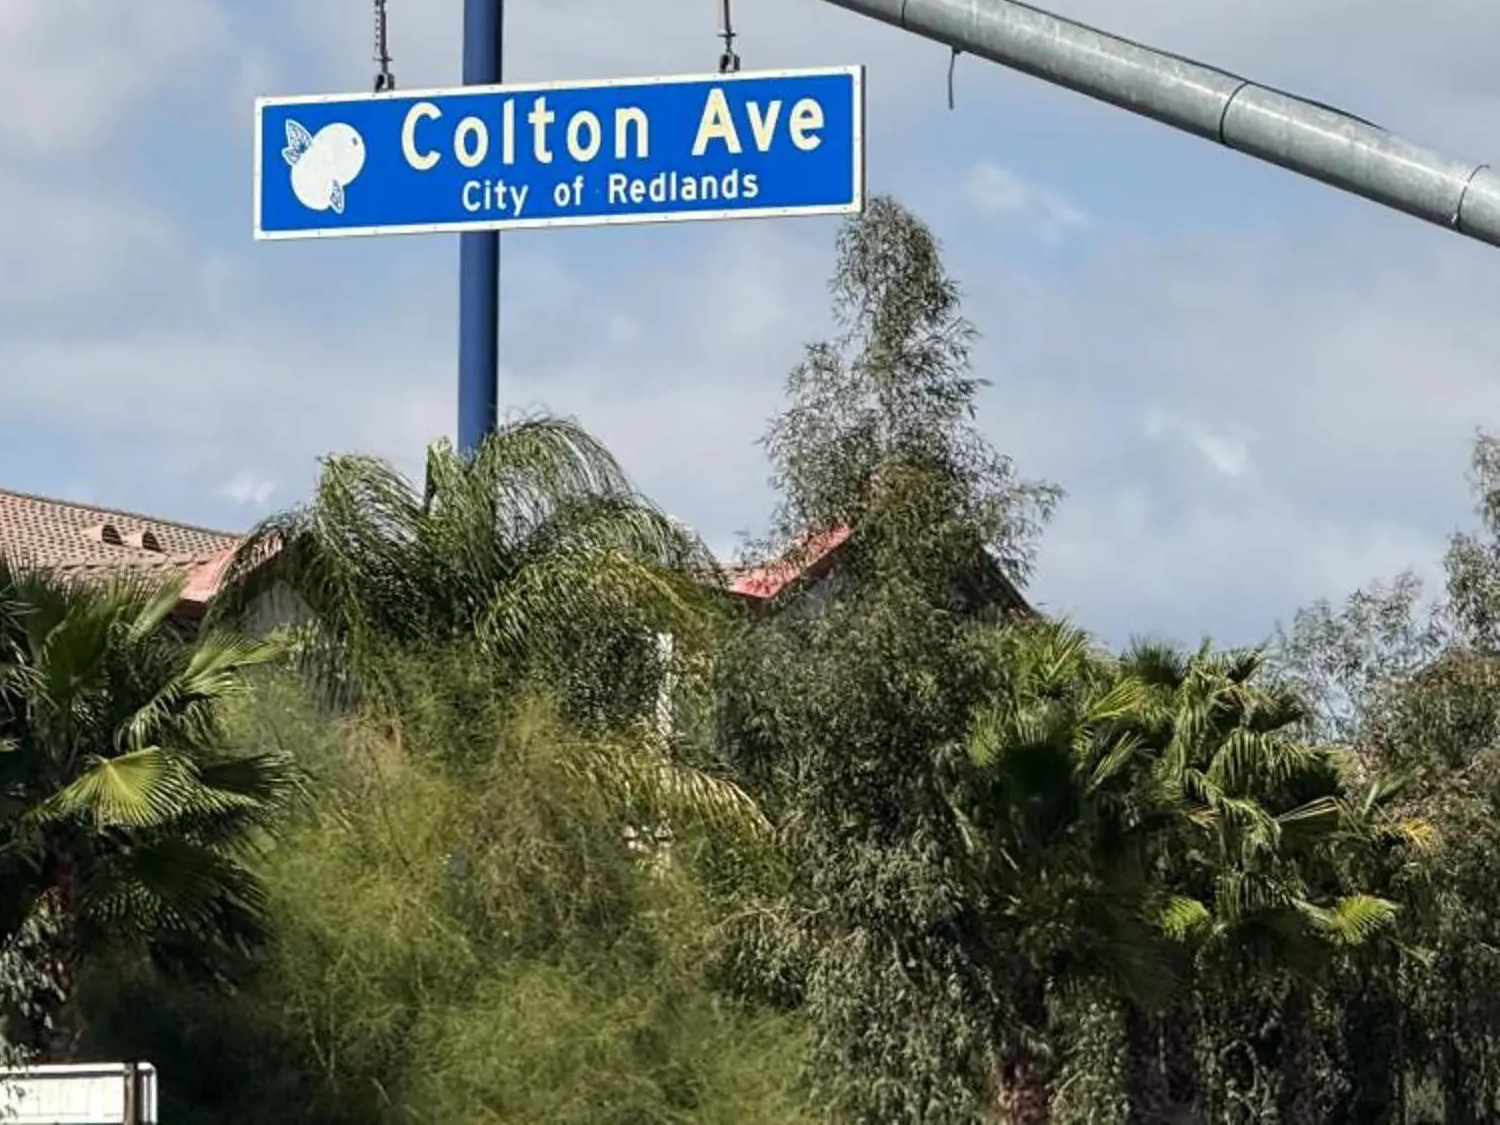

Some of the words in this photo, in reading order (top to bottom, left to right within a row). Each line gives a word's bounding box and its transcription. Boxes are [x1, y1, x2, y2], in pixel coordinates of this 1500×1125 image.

[401, 96, 649, 171] Colton
[692, 88, 825, 156] Ave
[461, 180, 529, 216] City
[555, 178, 583, 208] of
[607, 169, 759, 204] Redlands
